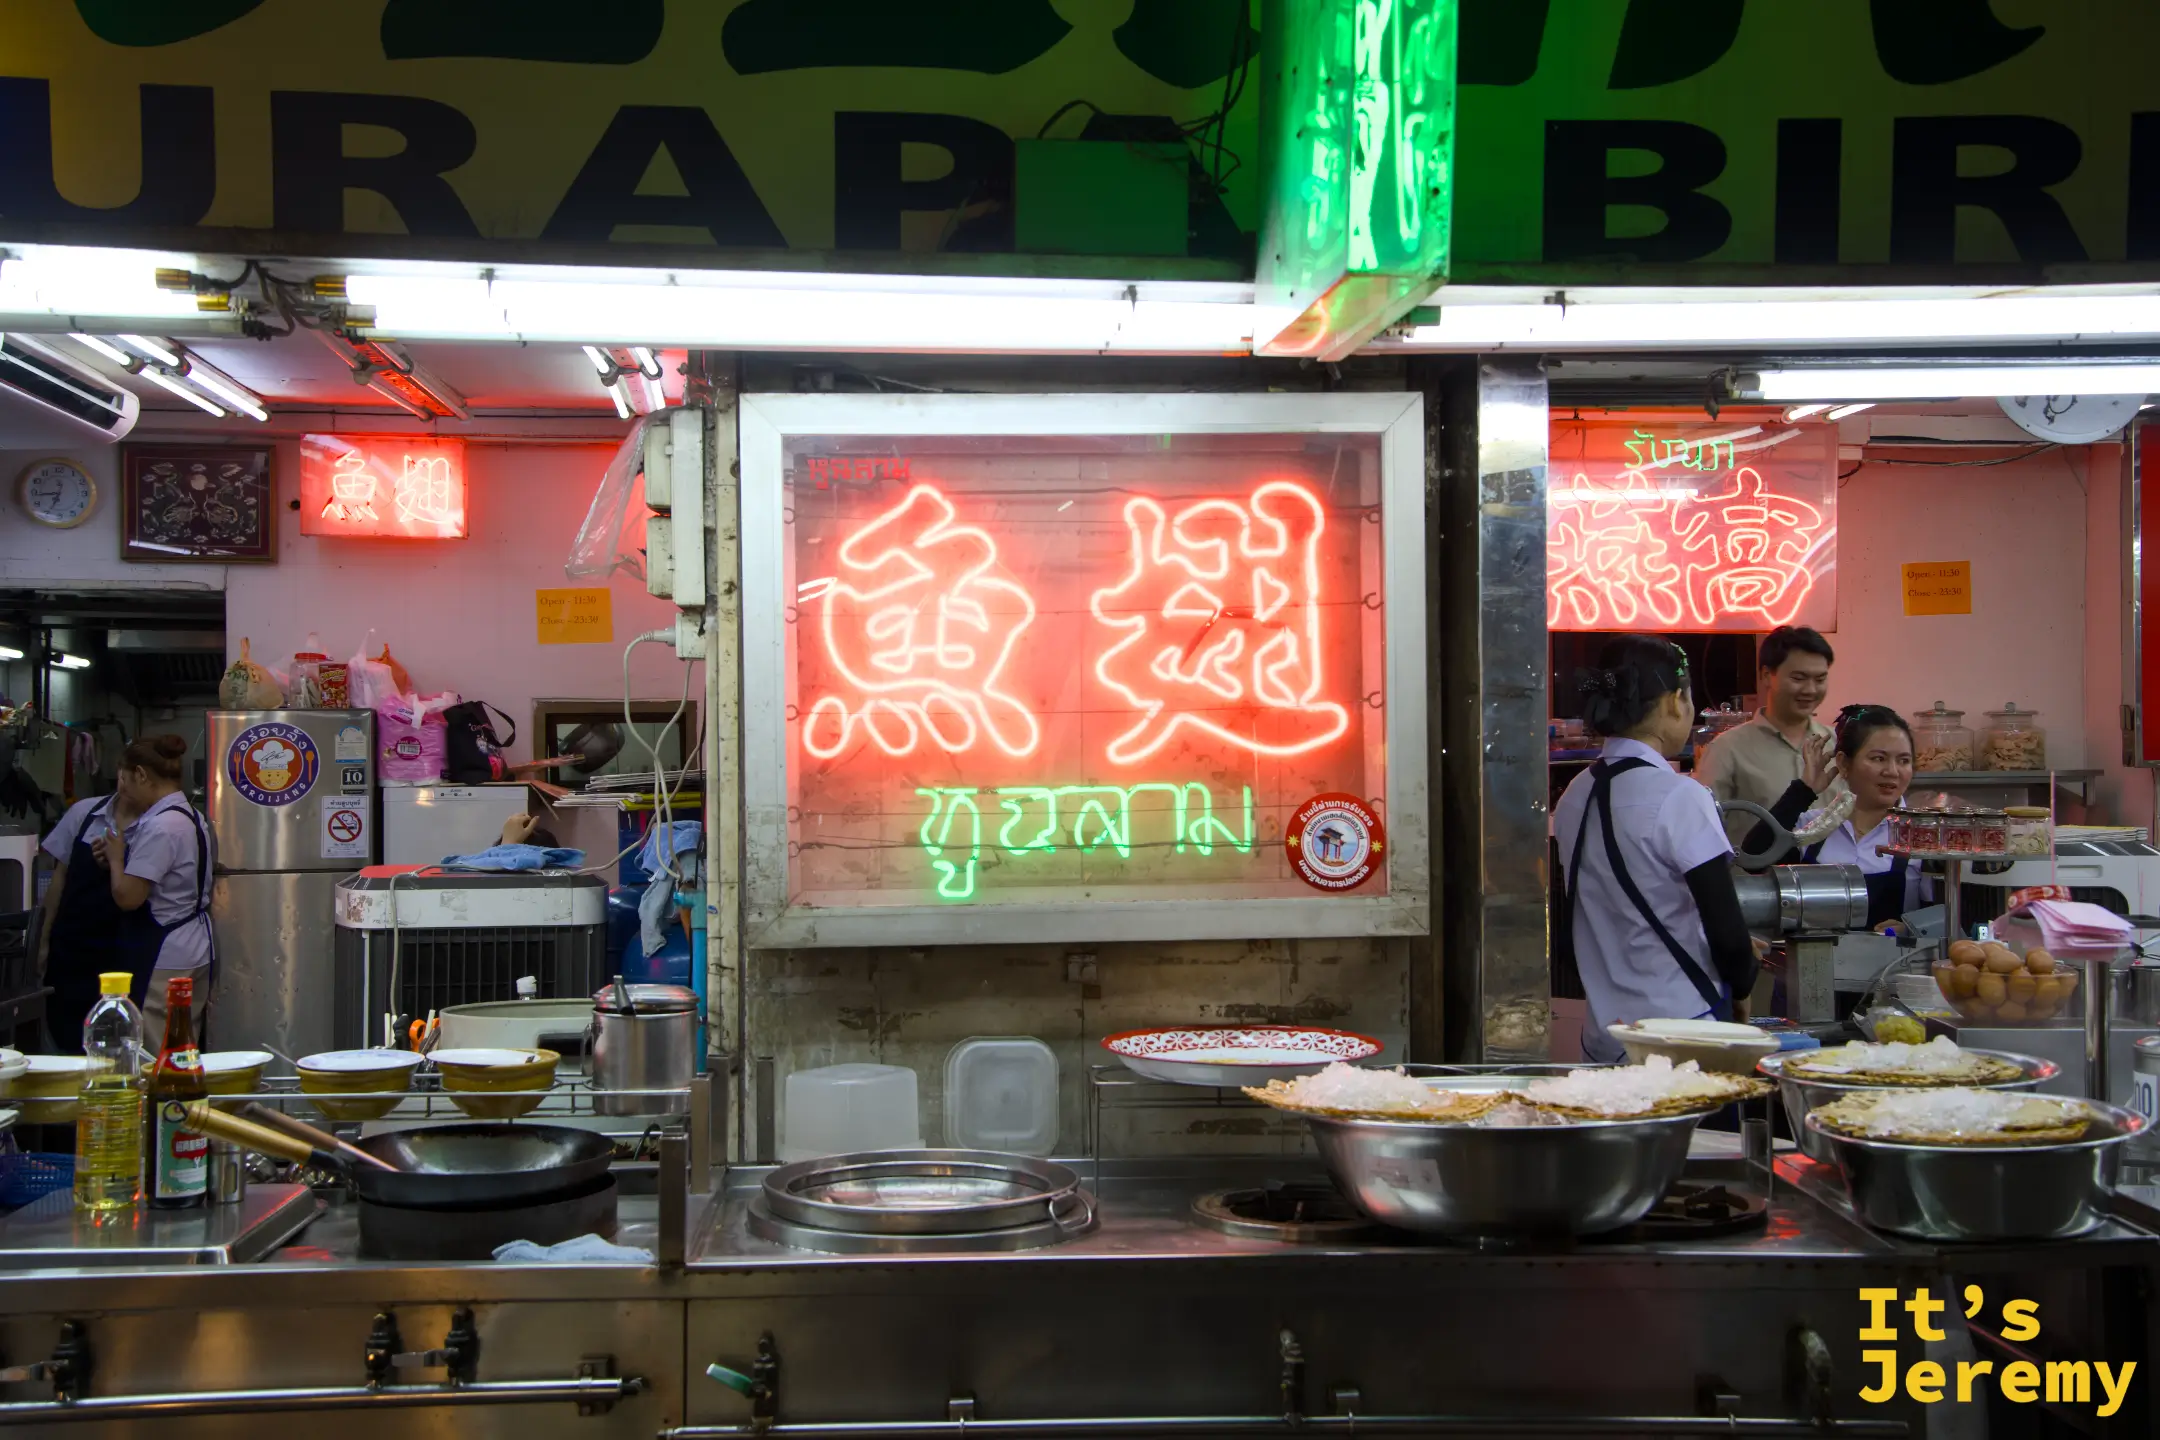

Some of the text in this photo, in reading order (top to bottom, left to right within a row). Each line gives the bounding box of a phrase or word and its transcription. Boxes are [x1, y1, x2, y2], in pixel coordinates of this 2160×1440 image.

[1542, 112, 2160, 264] BIR
[1623, 429, 1735, 471] รังนก
[321, 449, 450, 524] 魚翅
[807, 457, 911, 490] หูฉลาม
[1906, 571, 1929, 580] Open
[1939, 568, 1961, 577] 11:30
[540, 597, 565, 607] Open
[573, 595, 597, 605] 11:30
[1907, 588, 1931, 597] Close
[1939, 587, 1963, 596] 23:30
[540, 616, 565, 625] Close
[573, 615, 599, 624] 23:30
[802, 482, 1349, 764] 魚翅
[344, 771, 363, 783] 10
[239, 782, 307, 803] AROIJANG
[1299, 799, 1374, 827] ร้านนี้ผ่านการรับรอง
[1298, 859, 1370, 888] มาตรฐานอาหารปลอดภัย
